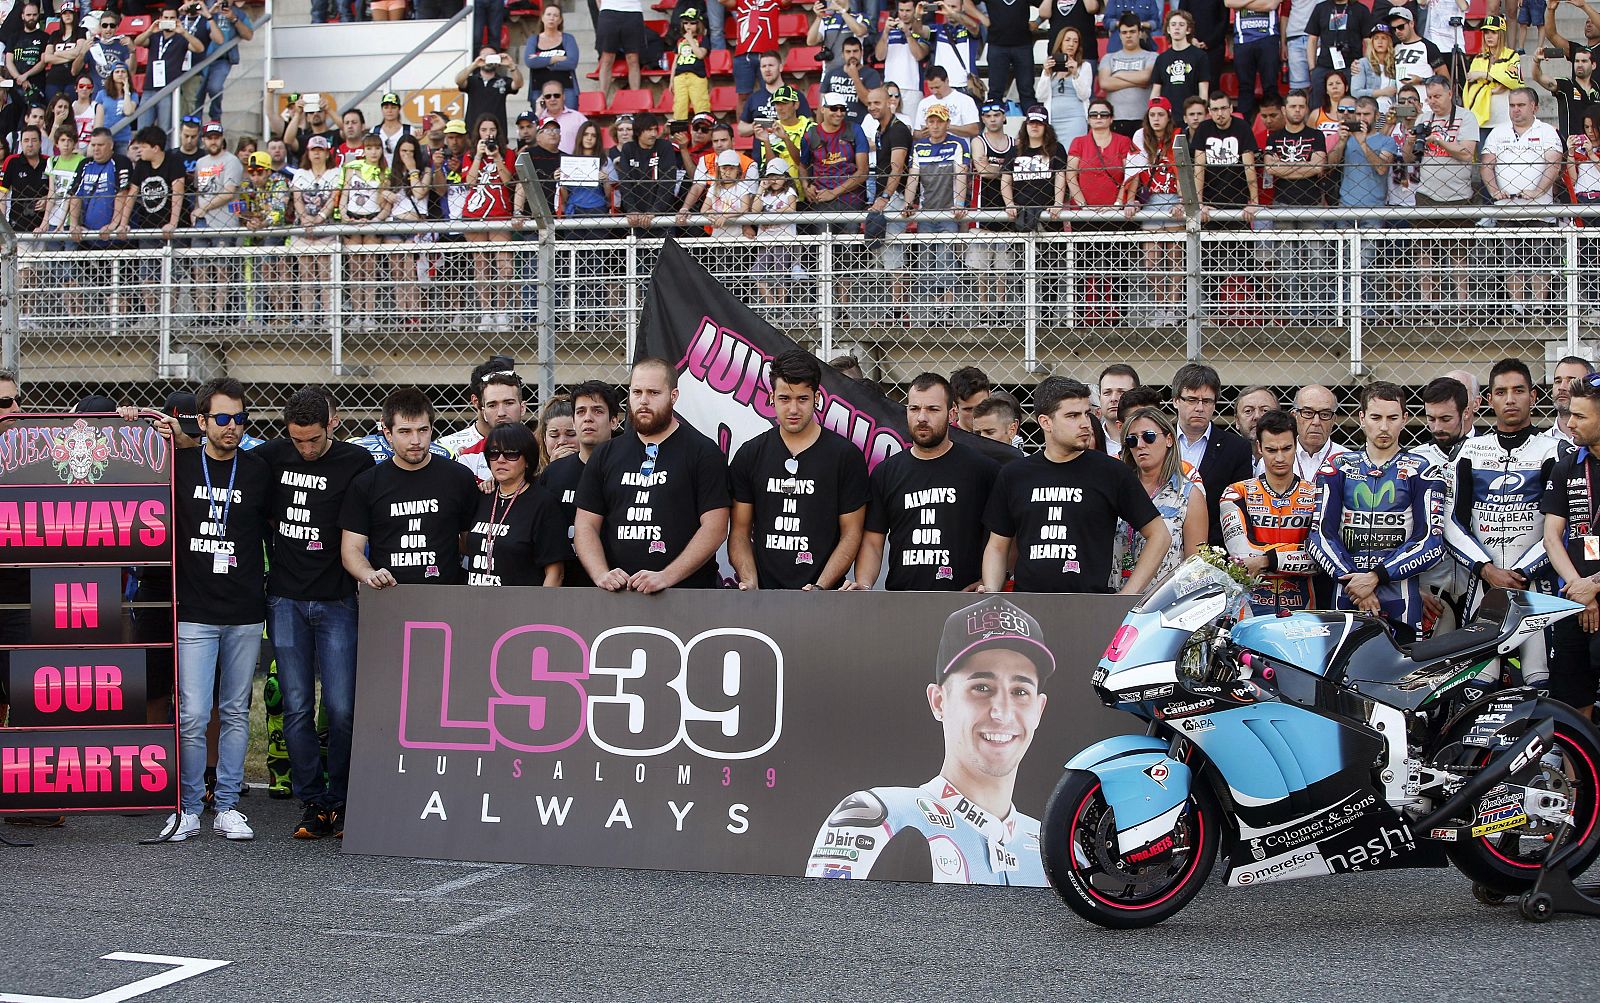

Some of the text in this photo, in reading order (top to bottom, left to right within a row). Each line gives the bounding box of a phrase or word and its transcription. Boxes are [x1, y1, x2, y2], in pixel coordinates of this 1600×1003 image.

[1395, 49, 1420, 65] 46
[830, 75, 847, 85] MAY
[831, 84, 857, 94] FORCE
[413, 94, 441, 117] 11
[1206, 136, 1240, 161] 39
[280, 470, 328, 491] ALWAYS
[621, 470, 668, 488] ALWAYS
[766, 478, 815, 495] ALAYS
[193, 485, 242, 504] ALWAYS
[292, 491, 307, 506] IN
[635, 490, 649, 504] IN
[904, 487, 957, 510] ALWAYS
[1030, 487, 1083, 503] ALWAYS
[1485, 493, 1524, 503] POWER
[208, 505, 223, 520] IN
[286, 506, 311, 523] OUR
[390, 498, 439, 517] ALWAYS
[626, 506, 653, 522] OUR
[782, 498, 797, 514] IN
[1047, 506, 1063, 521] IN
[1473, 501, 1539, 512] ELECTRONICS
[0, 500, 166, 547] ALWAYS
[408, 518, 422, 532] IN
[774, 516, 800, 532] OUR
[920, 508, 935, 525] IN
[1250, 513, 1312, 529] REPSOL
[1352, 513, 1405, 526] ENEOS
[1478, 511, 1534, 523] PULL&BEAR
[278, 521, 320, 541] HEARTS
[617, 525, 662, 541] HEARTS
[911, 528, 941, 545] OUR
[1040, 525, 1067, 540] OUR
[1354, 533, 1403, 542] MONSTER
[189, 537, 236, 555] HEARTS
[400, 534, 427, 549] OUR
[765, 533, 809, 551] HEARTS
[390, 551, 436, 567] HEARTS
[902, 549, 950, 566] HEARTS
[1029, 544, 1077, 560] HEARTS
[1307, 540, 1336, 578] YAMAHA
[1399, 544, 1443, 575] movistar
[54, 582, 98, 629] IN
[1252, 593, 1303, 606] Red Bull
[967, 611, 1031, 637] LS39
[33, 665, 123, 713] OUR
[400, 620, 784, 760] LS39
[1192, 685, 1222, 693] modyo
[1162, 698, 1216, 716] Camarón
[1167, 701, 1187, 710] Don
[1508, 735, 1544, 774] SC
[2, 744, 168, 794] HEARTS
[420, 790, 750, 835] ALWAYS
[1265, 795, 1376, 848] Colomer & Sons
[1485, 817, 1525, 833] DUNLOP
[1311, 830, 1325, 842] por
[1131, 835, 1174, 864] PROJECTS
[1326, 817, 1415, 874] nashi
[1255, 851, 1321, 879] merefsa
